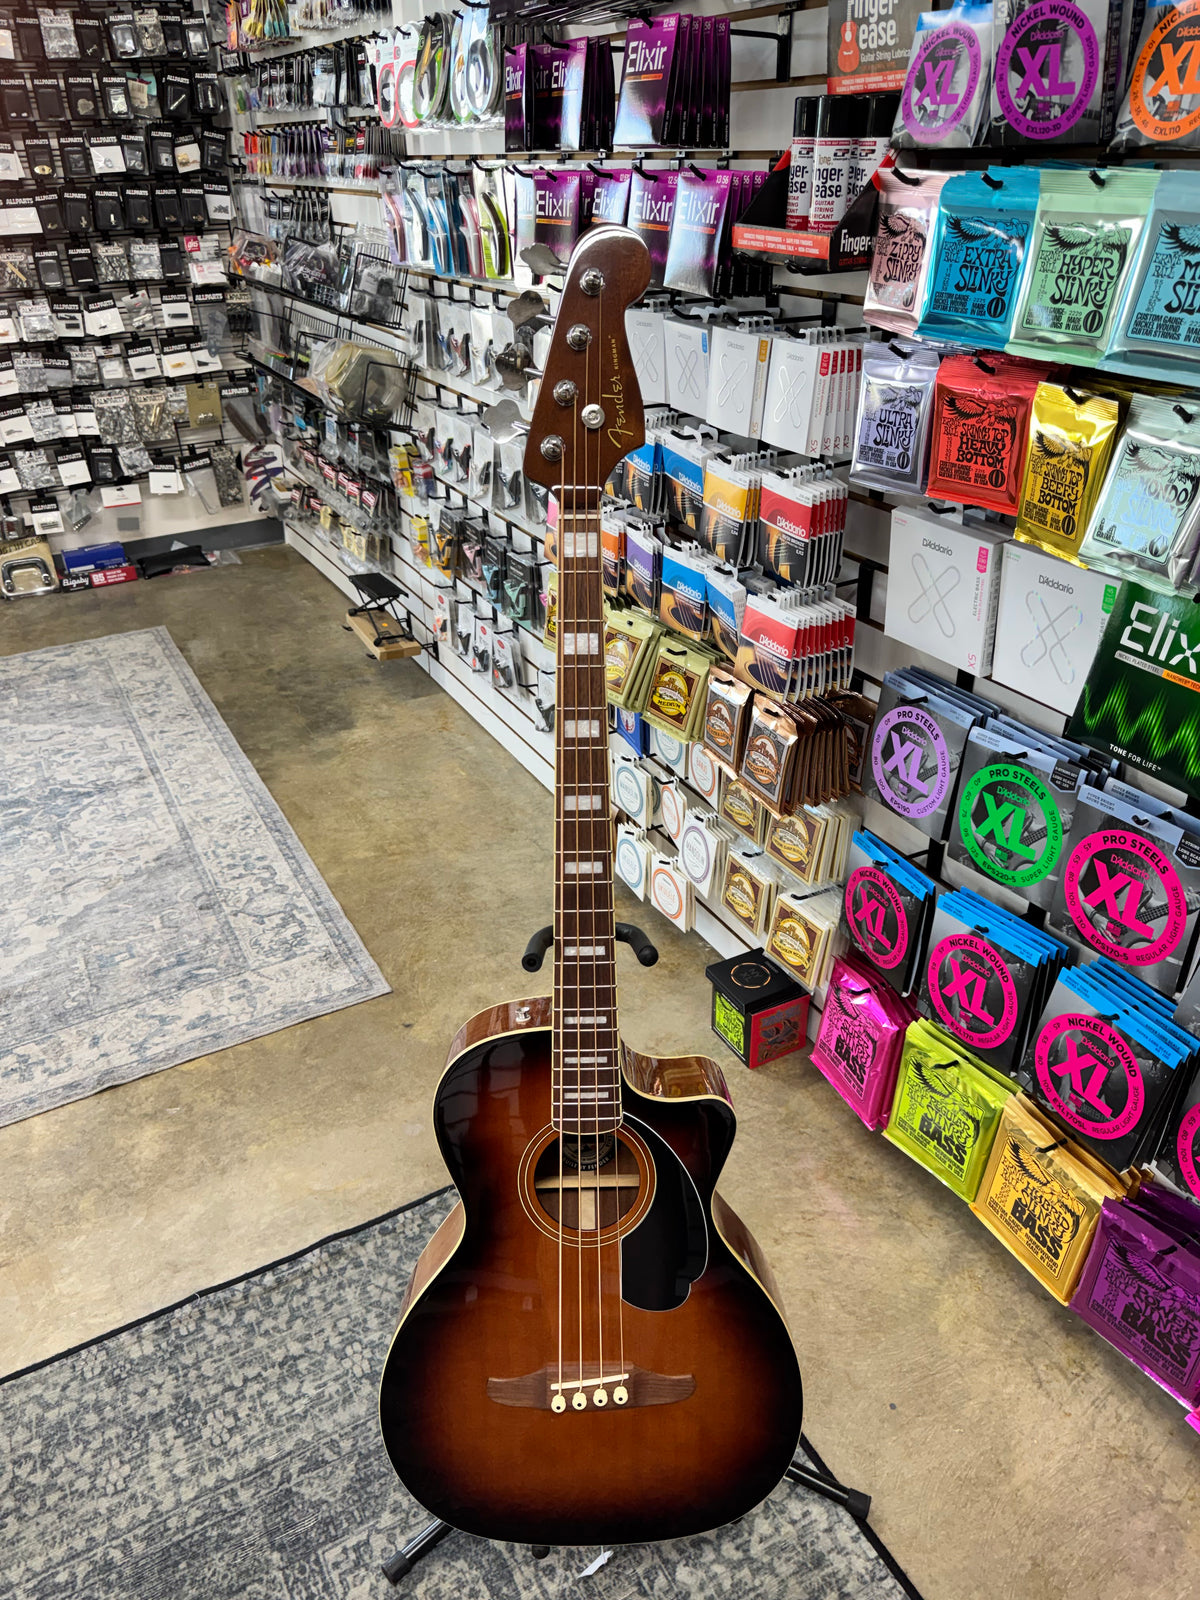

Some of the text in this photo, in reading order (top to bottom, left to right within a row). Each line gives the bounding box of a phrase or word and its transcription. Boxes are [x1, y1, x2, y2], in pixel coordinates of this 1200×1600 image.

[1011, 5, 1085, 38] NICKEL WOUND
[1159, 2, 1199, 34] NICKEL
[858, 19, 898, 49] ease
[953, 27, 976, 48] WOUND
[626, 41, 667, 73] Elixir
[505, 67, 522, 92] Elixir
[914, 60, 960, 106] XL
[1014, 43, 1076, 99] XL
[1065, 35, 1095, 122] SUPER LIGHT GAUGE
[1153, 125, 1181, 135] EXL110
[743, 176, 750, 184] 56
[754, 176, 761, 184] 56
[815, 184, 842, 198] ease
[536, 191, 572, 217] Elixir
[634, 190, 672, 222] Elixir
[680, 191, 720, 225] Elixir
[68, 248, 91, 256] ALLPARTS
[840, 229, 871, 256] Finger-
[962, 246, 1012, 270] EXTRA
[1058, 254, 1115, 281] HYPER
[195, 293, 223, 301] ALLPARTS
[1134, 319, 1181, 332] NICKEL WOUND
[1136, 312, 1184, 325] CUSTOM GAUGE
[1131, 327, 1181, 340] GUITAR STRINGS
[163, 344, 187, 352] ALLPARTS
[221, 387, 249, 396] ALLPARTS
[602, 375, 634, 448] Fender
[878, 409, 912, 430] ULTRA
[824, 437, 831, 451] XS
[961, 423, 1009, 442] SKINNY TOP
[57, 452, 82, 462] ALLPARTS
[810, 440, 818, 453] XS
[959, 437, 1007, 456] HEAVY
[184, 458, 210, 470] ALLPARTS
[956, 451, 1006, 469] BOTTOM
[1040, 478, 1079, 501] BEEFY
[1069, 470, 1083, 487] TOP
[1037, 490, 1077, 516] BOTTOM
[1141, 478, 1188, 506] MONDO
[32, 503, 58, 512] ALLPARTS
[777, 515, 806, 538] D'Addario
[922, 537, 953, 557] D'Addario
[62, 576, 89, 588] Bigsby
[677, 580, 702, 600] D'Addario
[1038, 574, 1074, 595] D'Addario
[759, 634, 789, 657] D'Addario
[1120, 601, 1200, 674] Elix
[897, 710, 940, 741] PRO STEELS
[883, 730, 929, 795] XL
[1109, 743, 1142, 764] TONE FOR
[916, 798, 937, 814] CUSTOM
[936, 779, 944, 800] LIGHT
[989, 768, 1010, 778] PRO
[1013, 771, 1046, 800] STEELS
[975, 791, 1036, 861] XL
[1049, 809, 1058, 842] GAUGE
[1045, 846, 1056, 870] LIGHT
[1103, 835, 1169, 875] PRO STEELS
[1110, 854, 1150, 880] D'Addario
[1021, 869, 1043, 883] SUPER
[1068, 842, 1092, 929] 45 65 80 100 130
[859, 870, 902, 913] NICKEL WOUND
[1083, 858, 1155, 940] XL
[855, 886, 891, 950] XL
[1090, 885, 1182, 962] EPS170-5 REGULAR LIGHT GAUGE
[949, 938, 1009, 984] NICKEL WOUND
[941, 956, 995, 1027] XL
[950, 1021, 974, 1042] EXL170
[1001, 1018, 1011, 1034] LIGHT
[835, 1034, 866, 1085] BASS
[1068, 1017, 1137, 1078] NICKEL WOUND
[1080, 1035, 1115, 1068] D'Addario
[1043, 1078, 1052, 1093] 100
[1050, 1034, 1113, 1119] XL
[930, 1095, 971, 1131] REGULAR
[1052, 1097, 1087, 1131] EXL170SL
[1092, 1122, 1120, 1133] REGULAR
[1119, 1110, 1135, 1129] LIGHT
[1187, 1116, 1197, 1127] 65
[919, 1113, 967, 1166] BASS
[1181, 1130, 1189, 1141] 80
[1186, 1171, 1197, 1186] 130
[1025, 1182, 1070, 1231] HYBRID
[1011, 1198, 1062, 1260] BASS
[1025, 1232, 1059, 1269] ROUNDWOUND
[1026, 1240, 1039, 1256] MADE
[1046, 1261, 1057, 1274] USA
[1104, 1272, 1129, 1298] BALL
[1105, 1259, 1138, 1287] ERNIE
[1137, 1283, 1198, 1332] POWER
[1121, 1302, 1191, 1368] BASS
